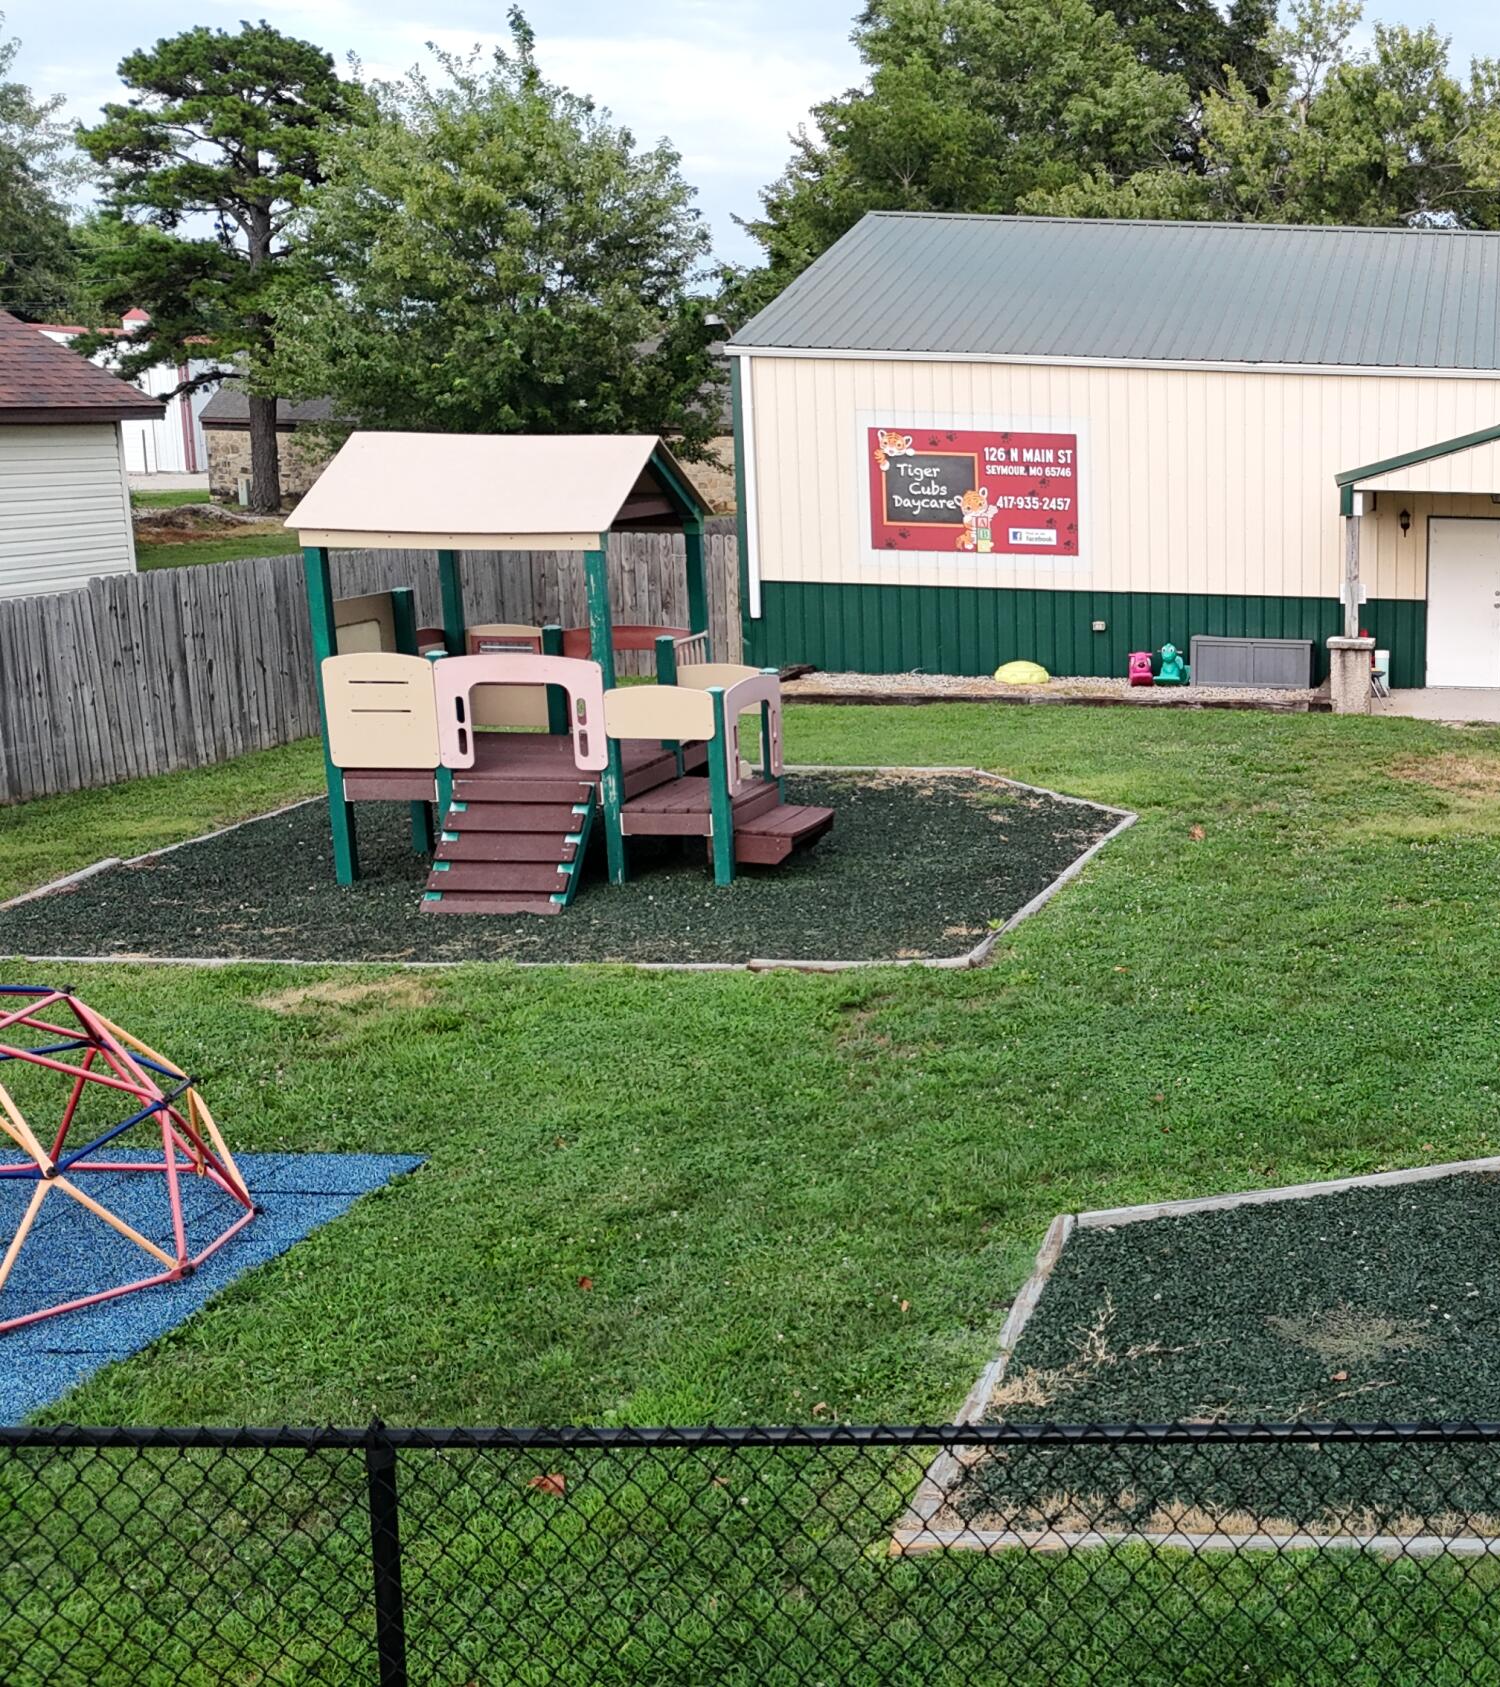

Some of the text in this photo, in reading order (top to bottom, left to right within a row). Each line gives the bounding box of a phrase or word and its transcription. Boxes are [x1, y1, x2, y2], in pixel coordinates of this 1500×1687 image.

[984, 447, 1073, 464] 126 N MAIN ST
[896, 463, 940, 481] Tiger
[1029, 466, 1043, 476] MO
[1045, 466, 1072, 477] 65746
[909, 480, 948, 496] Cubs
[892, 494, 957, 515] Daycare
